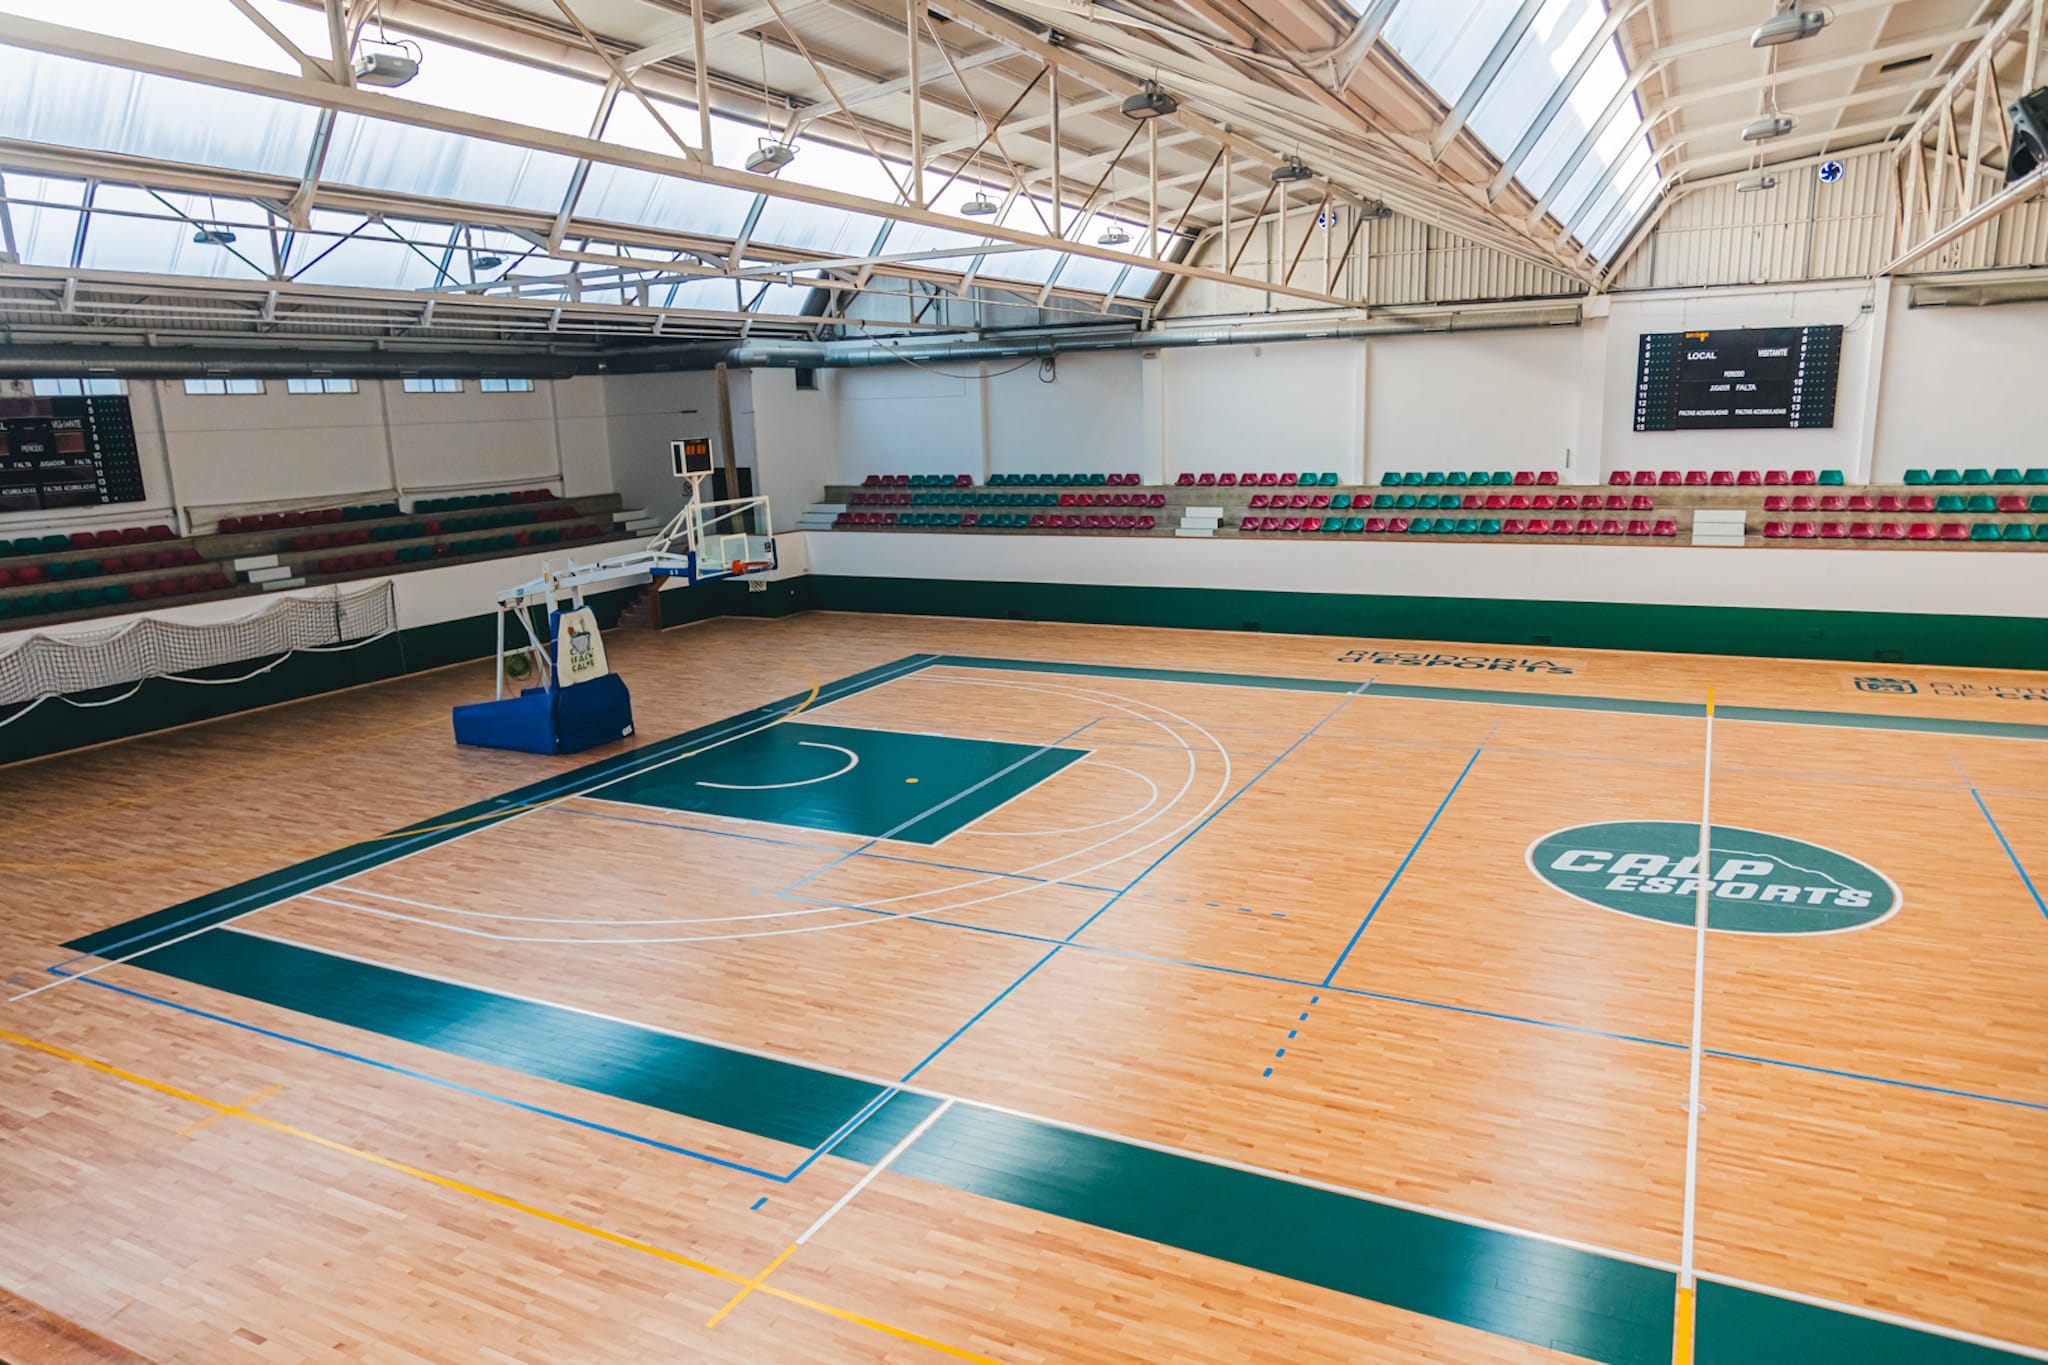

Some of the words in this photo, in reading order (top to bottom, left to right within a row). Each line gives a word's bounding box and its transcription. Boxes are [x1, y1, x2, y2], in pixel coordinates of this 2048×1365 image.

[1687, 352, 1717, 360] LOCAL
[1758, 348, 1788, 357] VISITANTE
[94, 460, 102, 468] 11
[1550, 848, 1774, 881] CALP
[1605, 875, 1873, 908] ESPORTS
